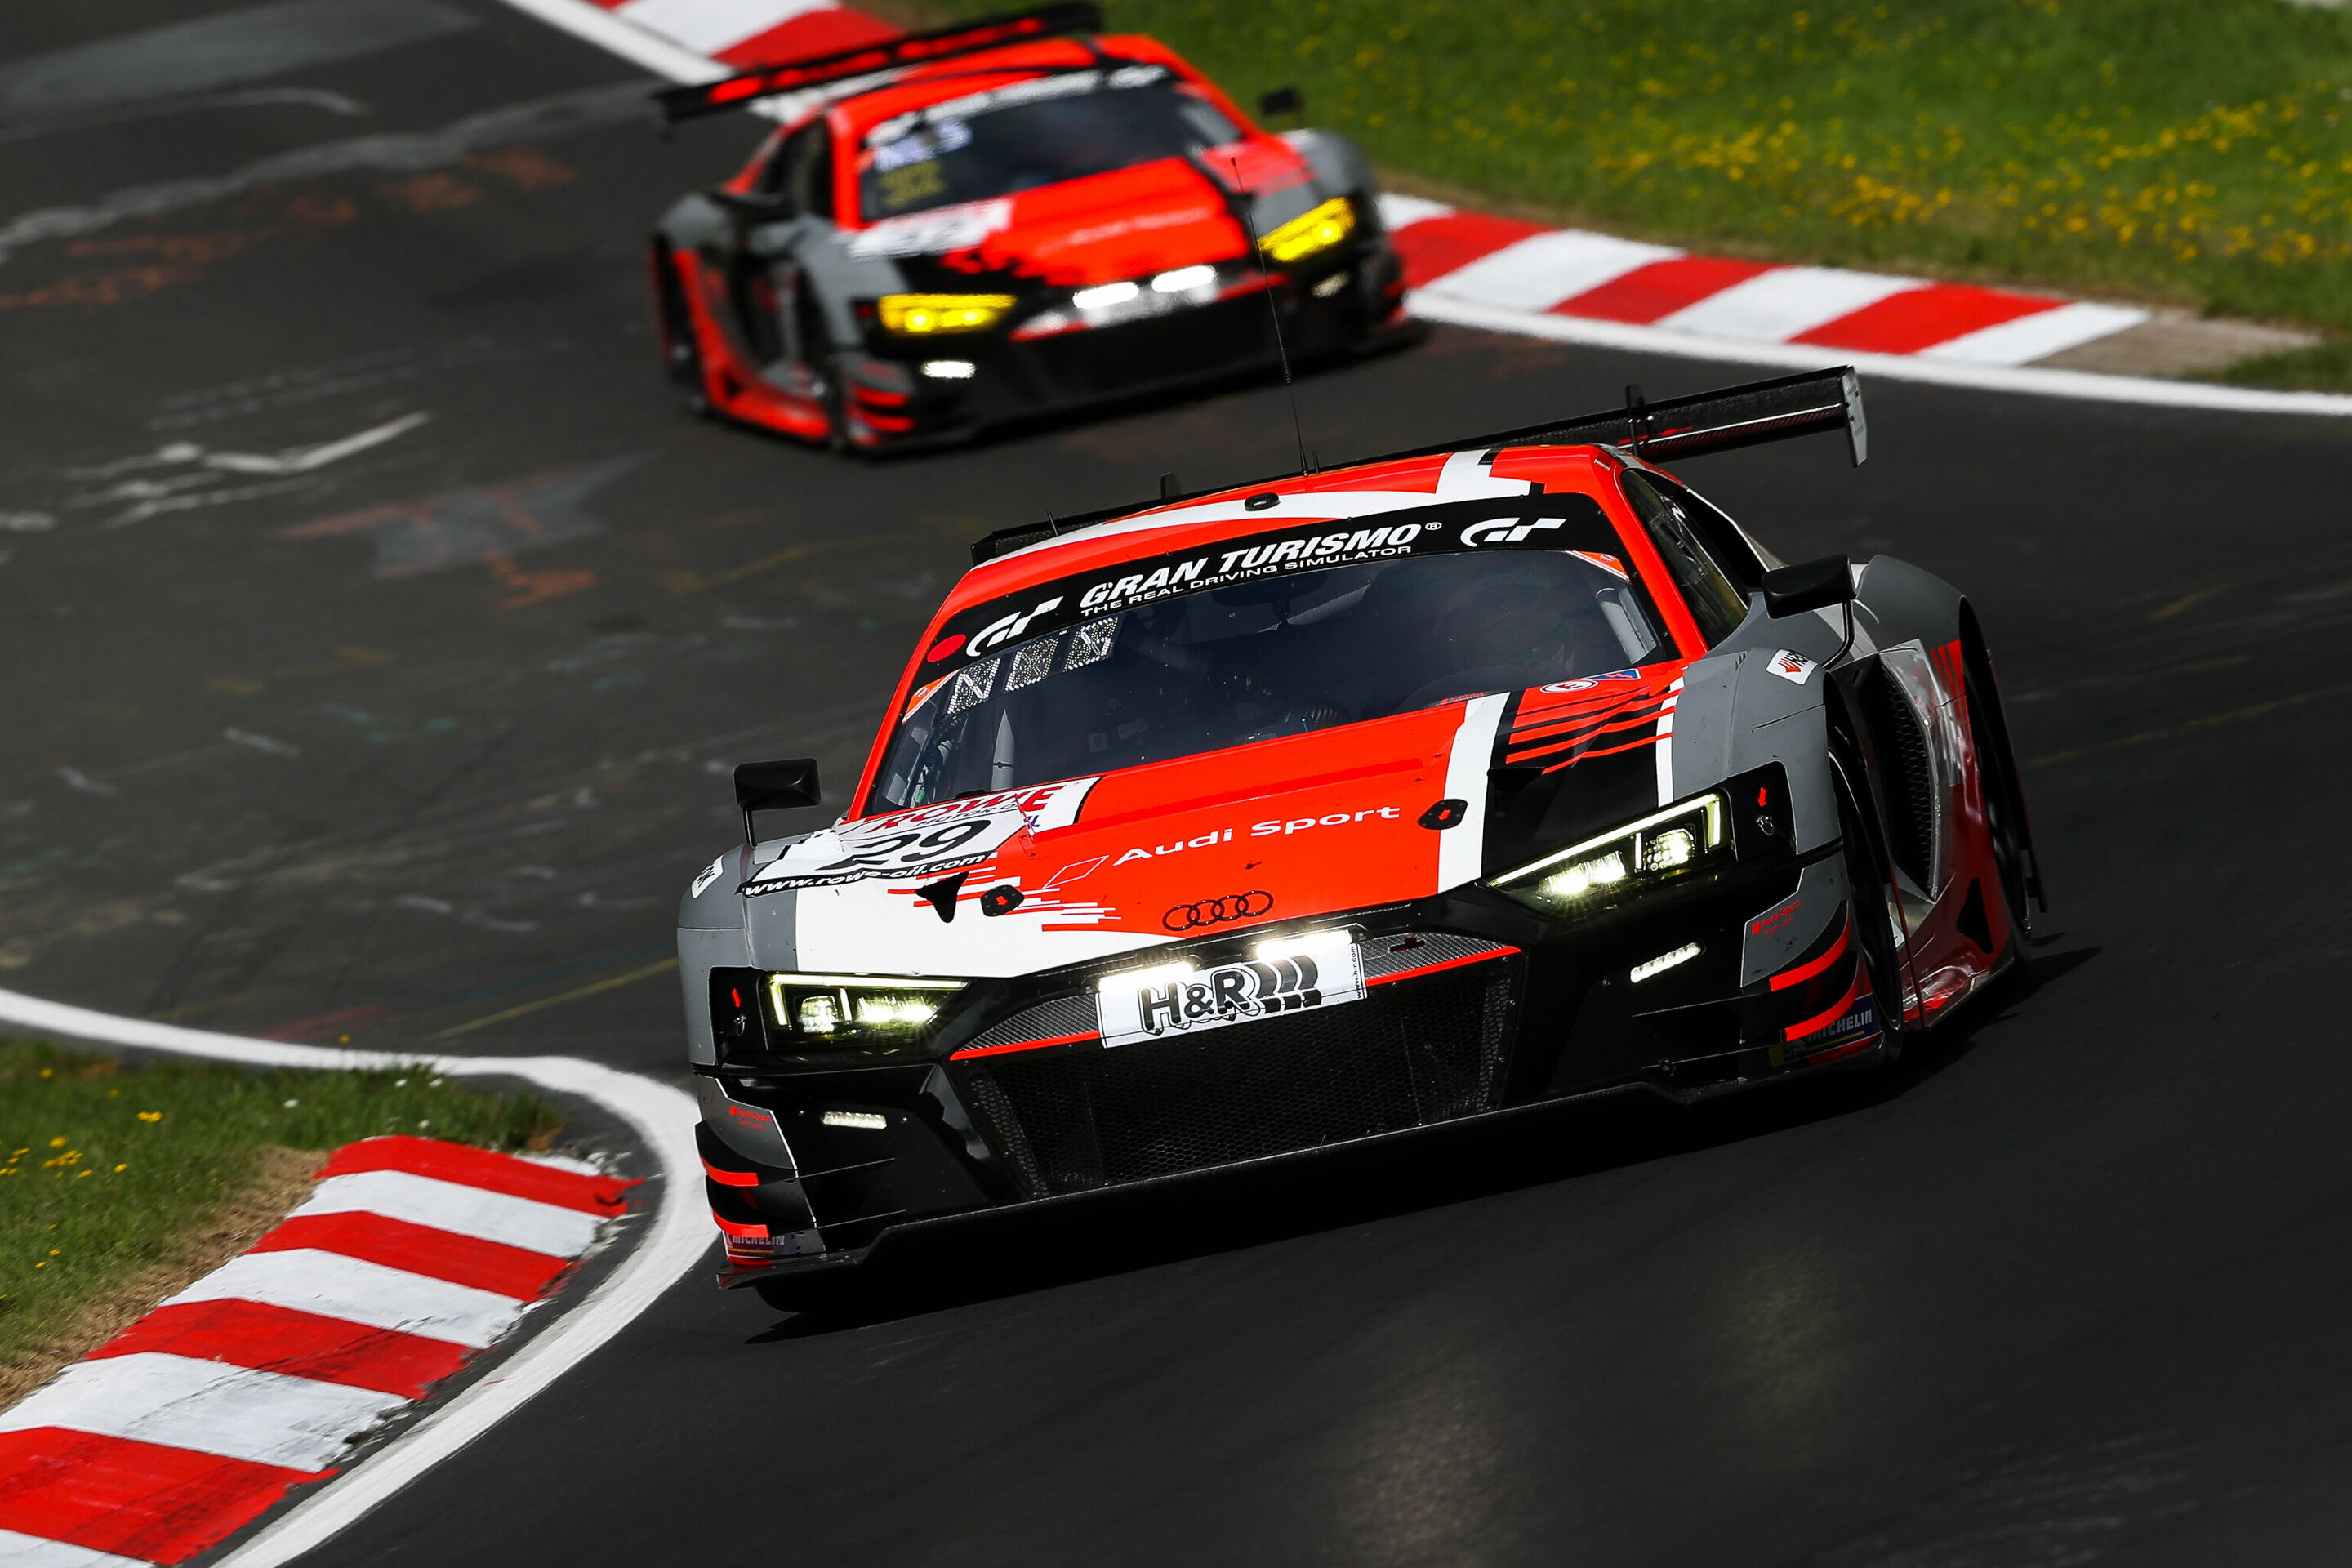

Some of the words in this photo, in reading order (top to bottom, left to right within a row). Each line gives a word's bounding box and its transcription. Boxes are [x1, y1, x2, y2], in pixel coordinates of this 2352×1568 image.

[1080, 557, 1209, 608] GRAN
[1219, 523, 1422, 571] TURISMO
[1081, 599, 1122, 617] THE
[1129, 586, 1184, 605] REAL
[1190, 565, 1277, 589] DRIVING
[1285, 546, 1411, 570] SIMULATOR
[864, 785, 1066, 833] ROWE
[1112, 829, 1233, 866] Audi
[1250, 805, 1401, 838] Sport
[815, 819, 991, 872] 29
[743, 854, 985, 896] www.rowe-oil.com
[1761, 911, 1780, 928] Audi
[1780, 900, 1802, 917] Sport
[1139, 966, 1254, 1032] H&R
[1807, 1009, 1873, 1042] MICHELIN
